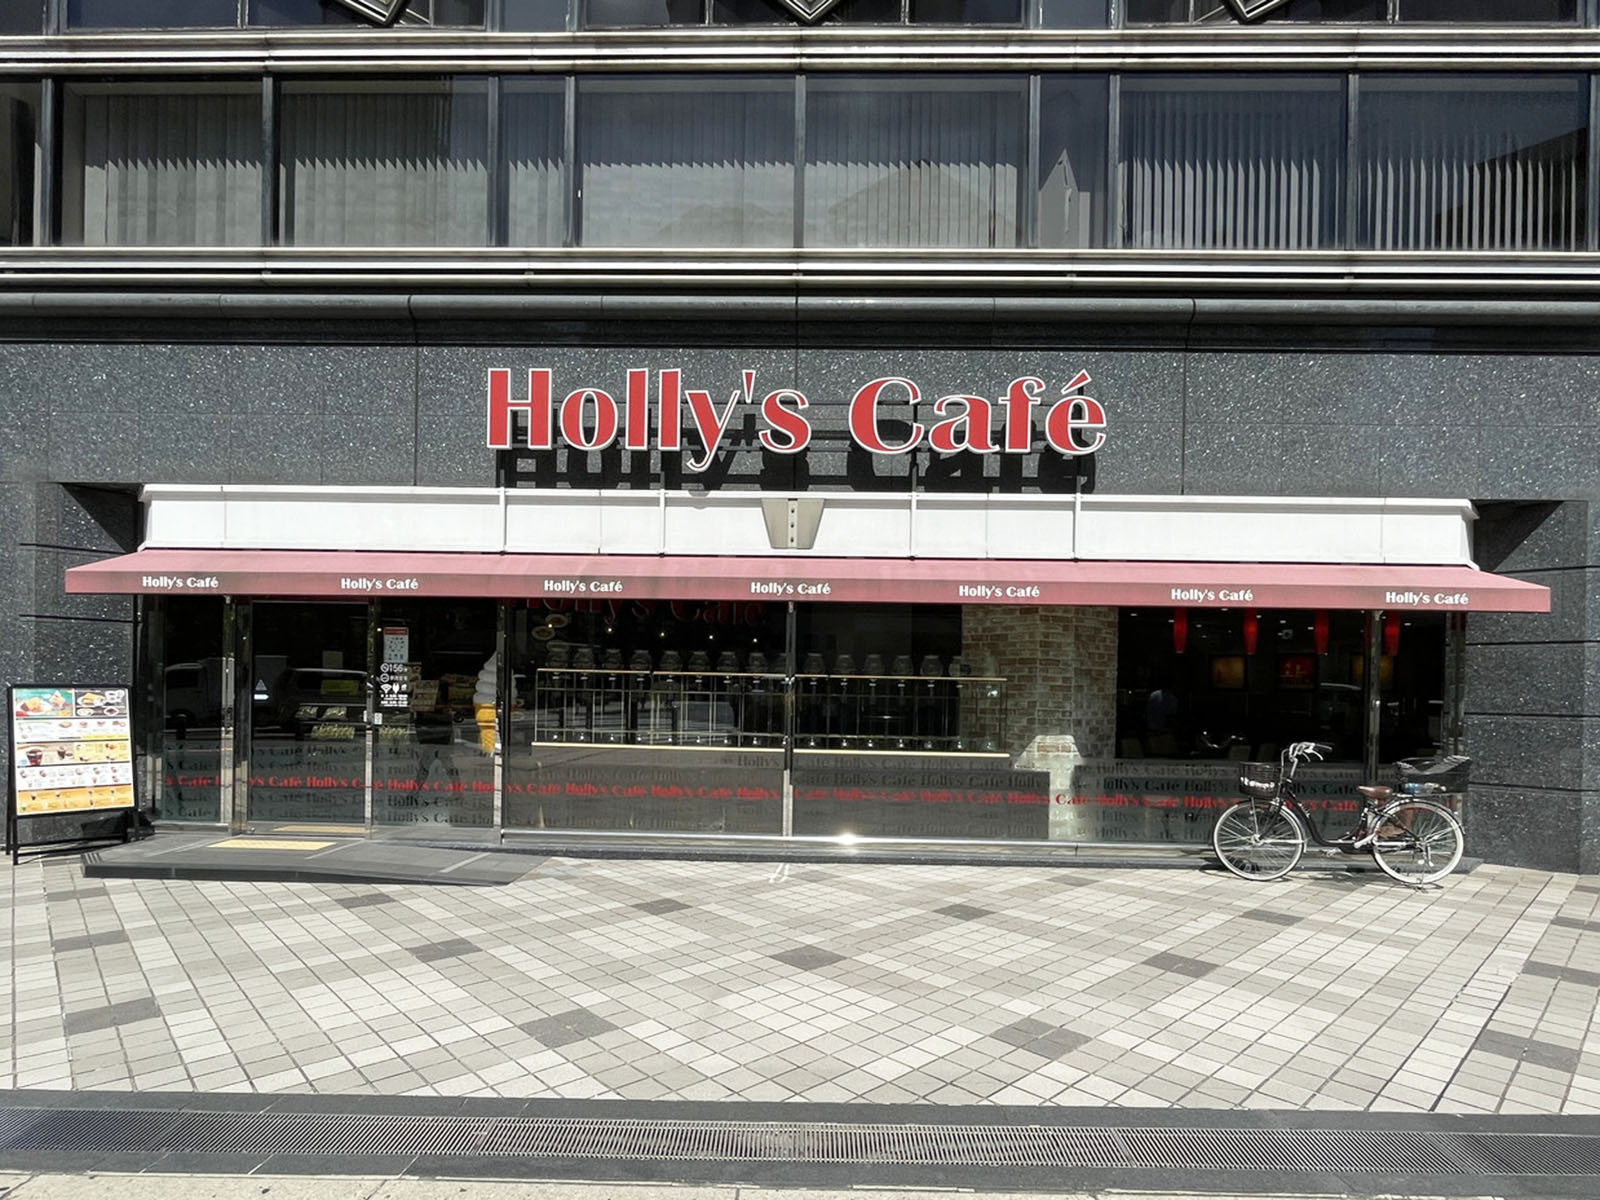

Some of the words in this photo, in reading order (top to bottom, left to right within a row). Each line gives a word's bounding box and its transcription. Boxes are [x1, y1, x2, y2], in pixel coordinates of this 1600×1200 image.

[486, 367, 812, 471] Holly's
[848, 369, 1107, 456] Café
[142, 576, 183, 591] Holly's
[186, 576, 219, 589] Café
[341, 577, 382, 592] Holly's
[386, 578, 418, 590] Café
[544, 579, 586, 593] Holly's
[589, 580, 623, 593] Café
[750, 582, 794, 596] Holly's
[797, 582, 831, 595] Café
[958, 585, 1002, 599] Holly's
[1006, 585, 1040, 598] Café
[1171, 588, 1215, 602] Holly's
[1218, 589, 1254, 602] Café
[1385, 592, 1431, 606] Holly's
[1433, 593, 1469, 605] Café
